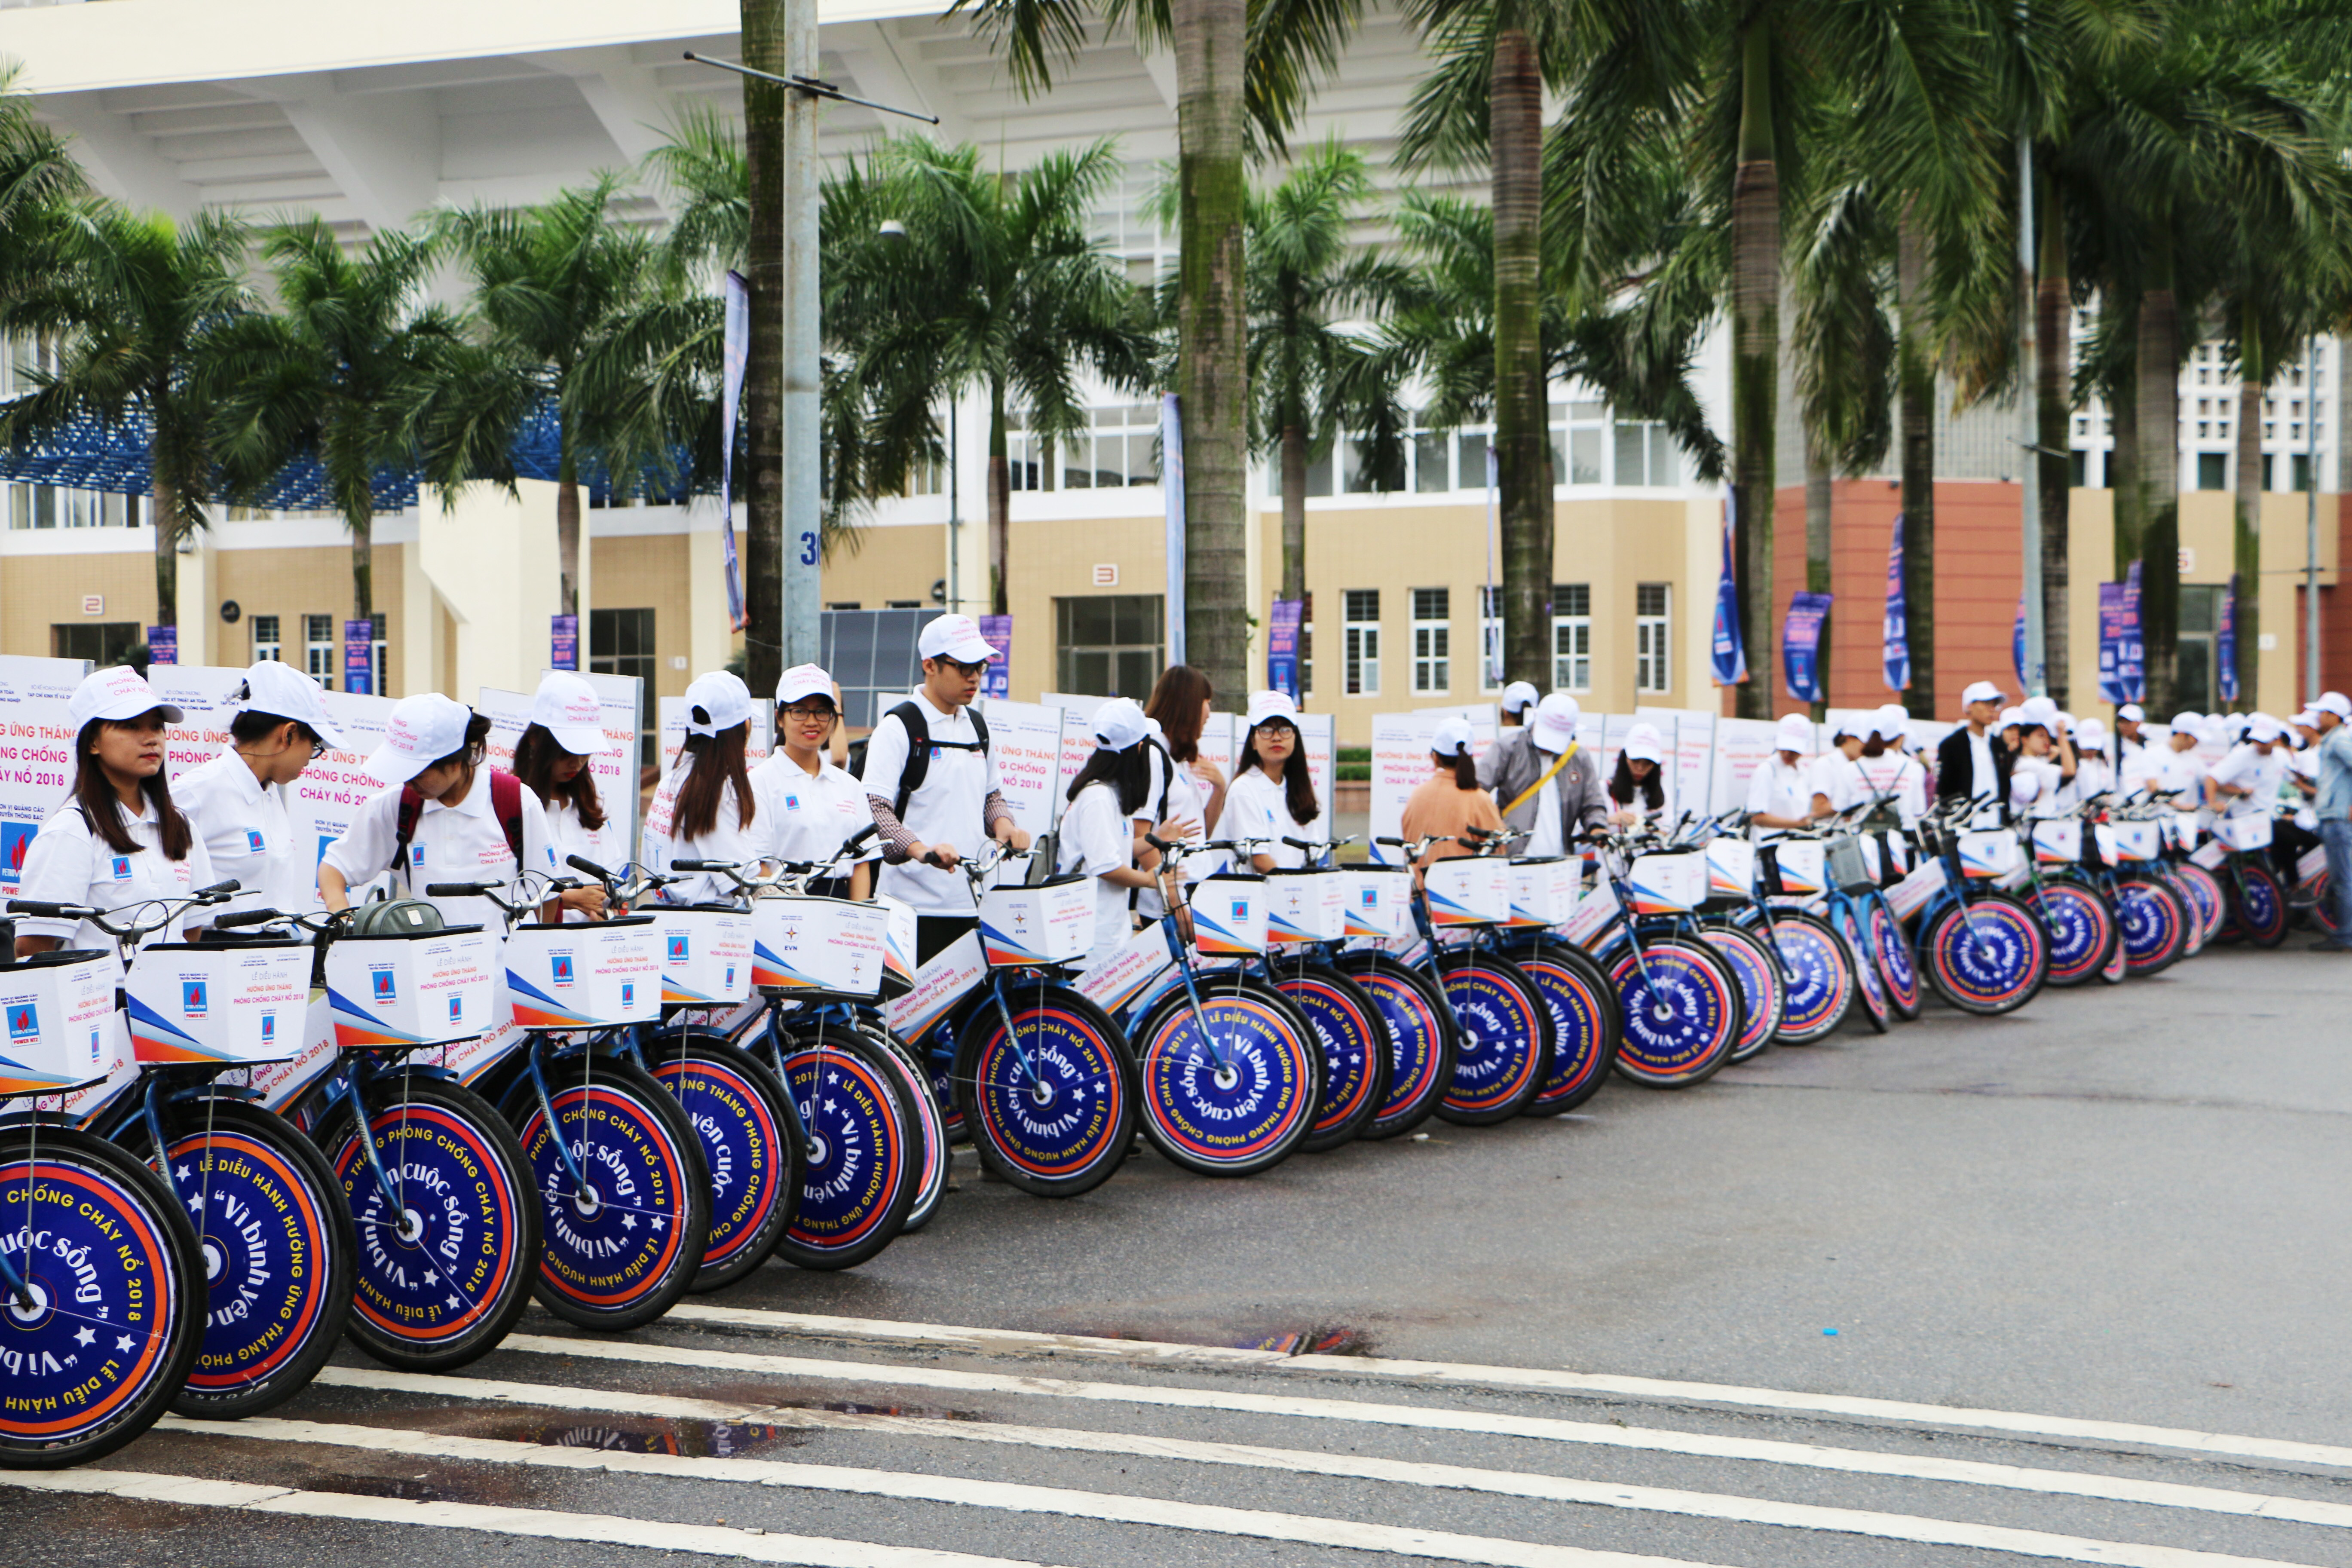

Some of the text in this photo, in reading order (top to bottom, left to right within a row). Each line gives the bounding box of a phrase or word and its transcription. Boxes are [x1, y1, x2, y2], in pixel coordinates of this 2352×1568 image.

[1098, 568, 1114, 582] 3
[86, 598, 100, 611] 2
[10, 721, 35, 737] ỨNG
[165, 726, 199, 741] ƯỞNG
[22, 745, 67, 763] CHỐNG
[169, 748, 212, 763] PHÒNG
[332, 749, 356, 764] ỨNG
[398, 743, 413, 751] 2018
[487, 728, 634, 759] ƯỞNG THÁNG
[1001, 744, 1022, 756] ỨNG
[15, 765, 64, 786] NỔ 2018
[599, 764, 620, 775] 2018
[1010, 761, 1046, 775] CHỐNG
[300, 787, 351, 804] CHÁY NỔ
[1020, 779, 1042, 789] 2018
[3, 886, 19, 895] POWE
[961, 966, 977, 980] 2018
[271, 994, 284, 1002] CHÁY
[458, 1019, 516, 1061] CHÁY 2018
[1040, 1024, 1068, 1036] CHÁY
[1083, 1048, 1100, 1074] 2018
[1168, 1031, 1188, 1054] 2018
[271, 1065, 293, 1086] CHÁY
[309, 1039, 329, 1058] 2018
[1192, 1048, 1271, 1121] bình cuộc
[870, 1119, 884, 1157] HÀNH
[710, 1084, 762, 1222] THÁNG PHÒNG CHỐNG
[712, 1145, 732, 1198] cuộc
[833, 1148, 861, 1191] bình
[590, 1115, 665, 1287] HÀNH CHÁY NỔ 2018
[359, 1125, 496, 1321] LỄ DIỄU HÀNH PHÒNG CHỐNG CHÁY NỔ 2018
[361, 1163, 450, 1267] bình cuộc
[7, 1183, 144, 1321] CHỐNG CHÁY NỔ 2018
[556, 1218, 593, 1259] bình
[199, 1154, 305, 1360] LỄ DIỄU HÀNH HƯỞNG ỨNG THÁNG
[242, 1220, 270, 1285] bình
[216, 1284, 259, 1325] yên
[5, 1359, 119, 1414] LỄ DIỄU HÀNH
